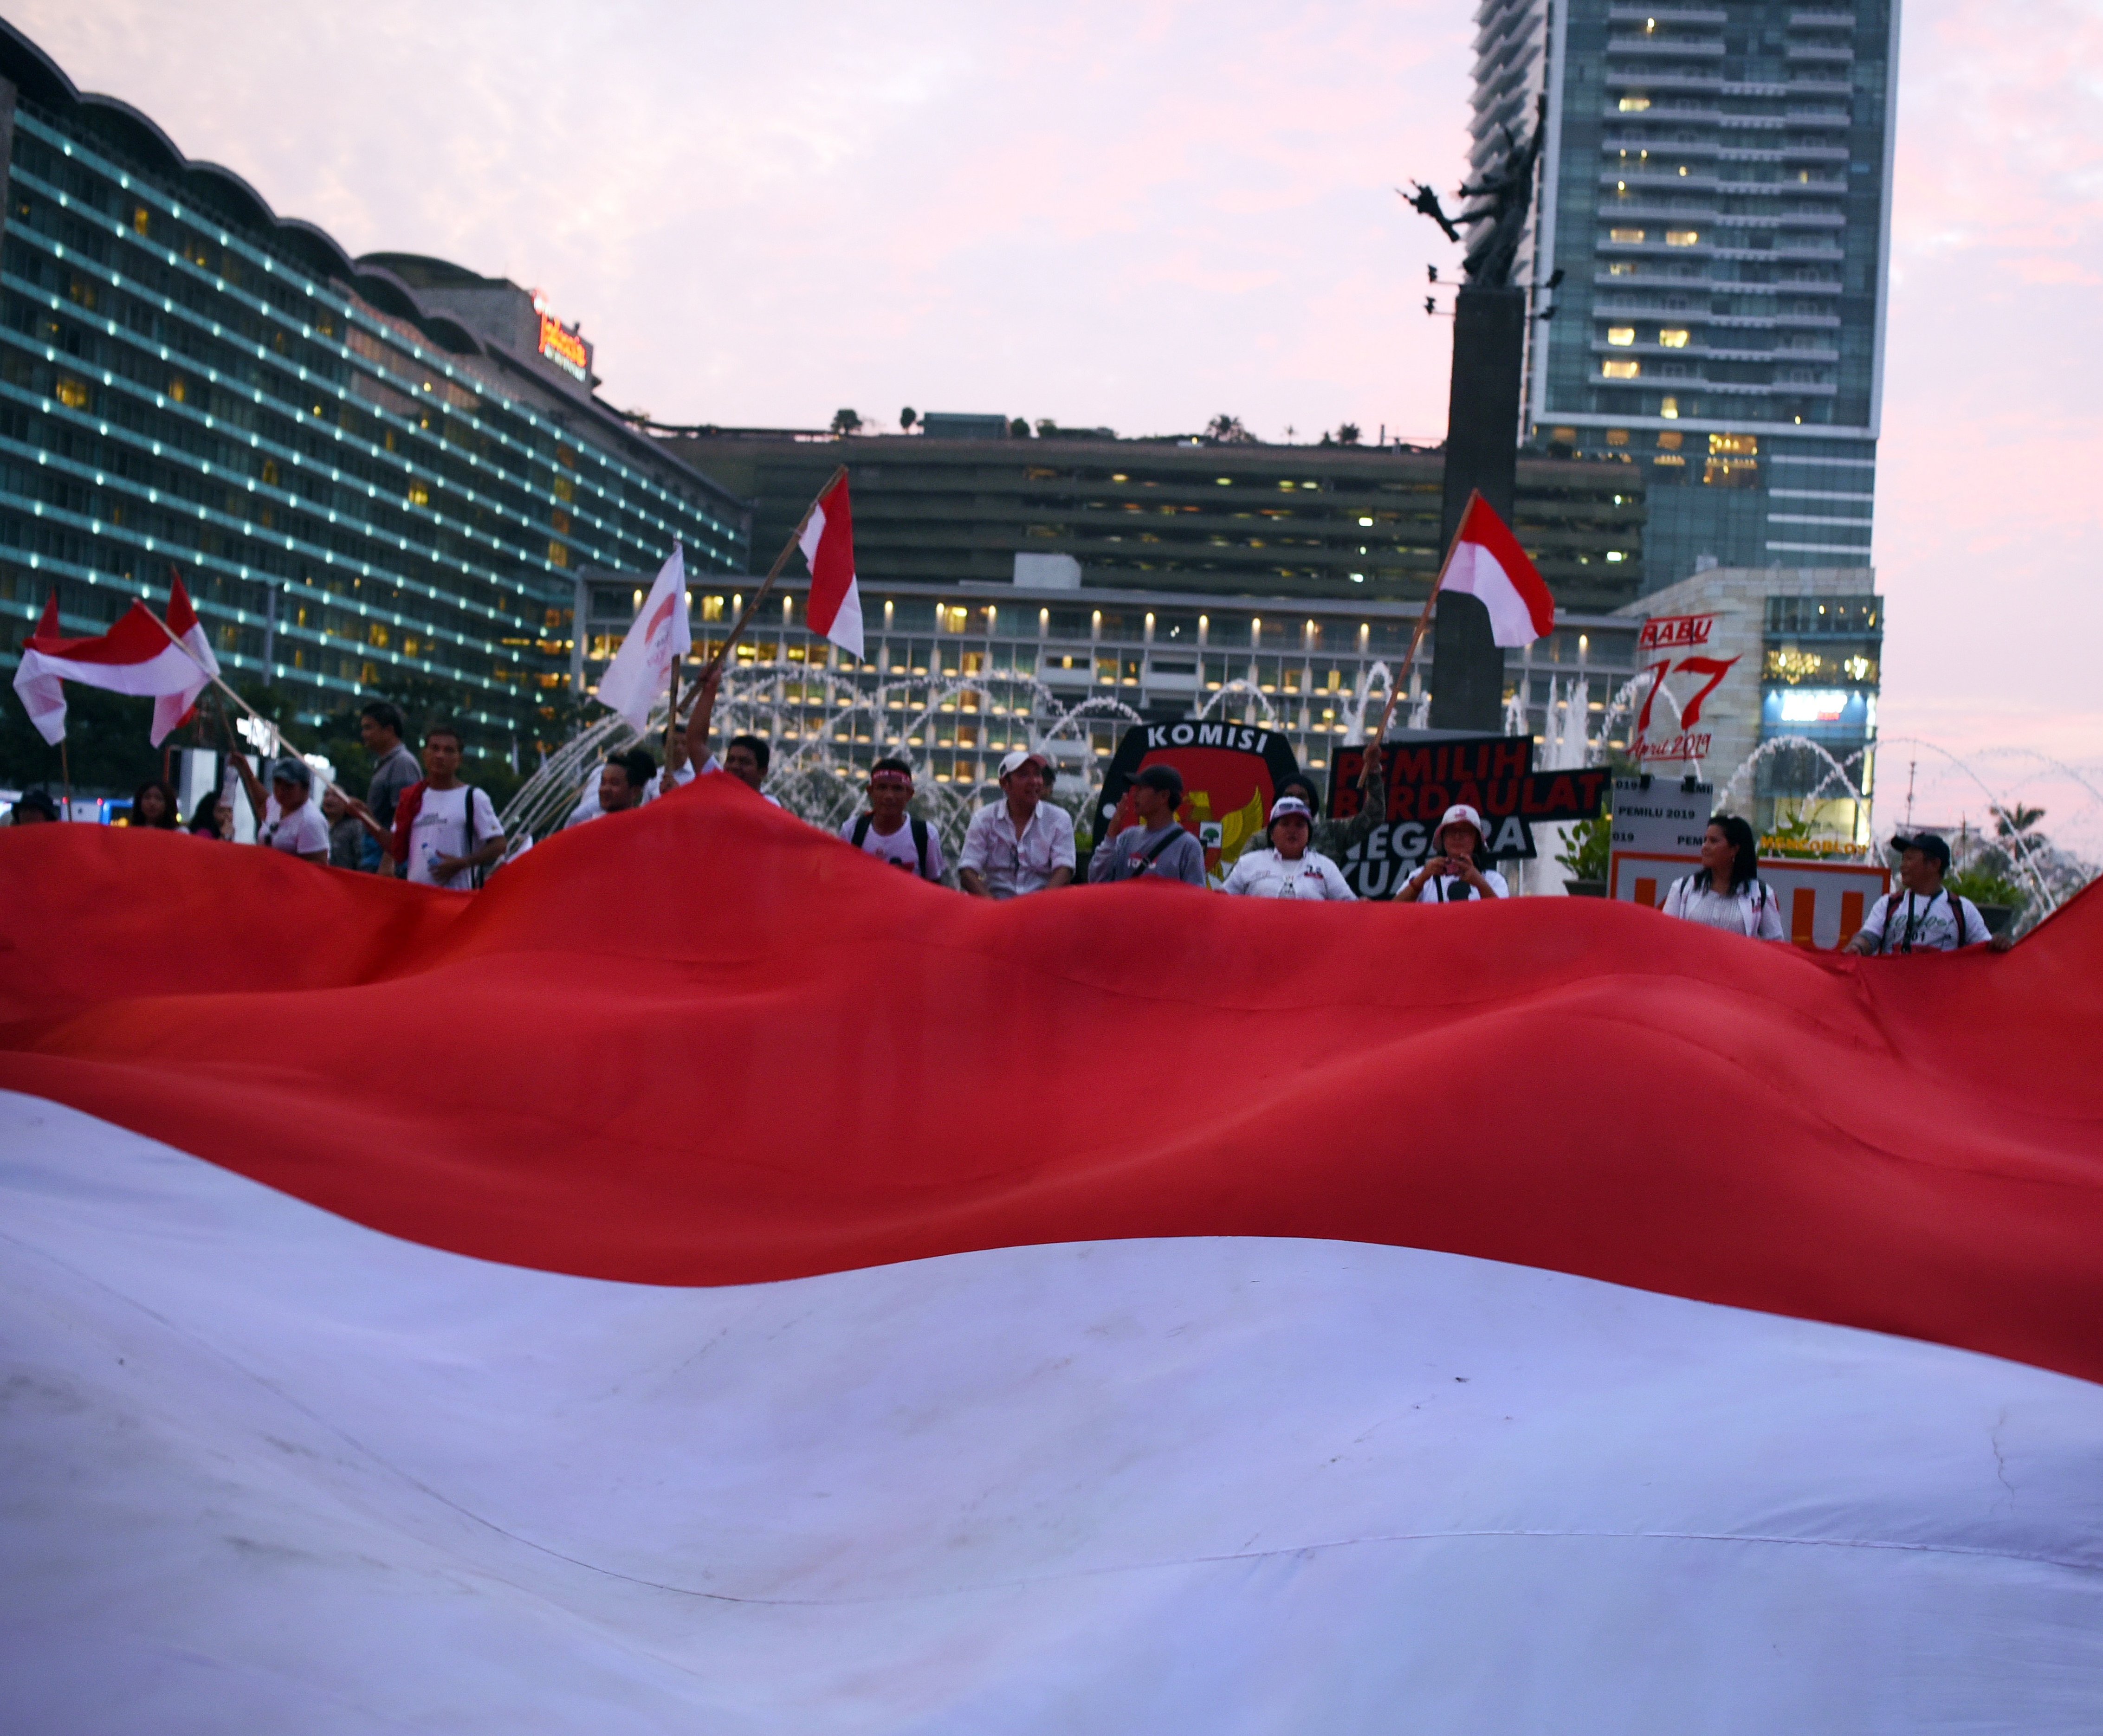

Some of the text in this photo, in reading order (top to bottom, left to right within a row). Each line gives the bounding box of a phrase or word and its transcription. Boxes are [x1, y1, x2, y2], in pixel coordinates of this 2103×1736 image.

[1639, 619, 1713, 644] RABU
[1637, 653, 1743, 733] 17
[1147, 723, 1268, 754] KOMISI
[1671, 733, 1711, 755] 2019
[1336, 742, 1527, 788] PMILIH
[1333, 772, 1604, 822] BRDAULAT
[1619, 807, 1695, 820] PEMILU 2019
